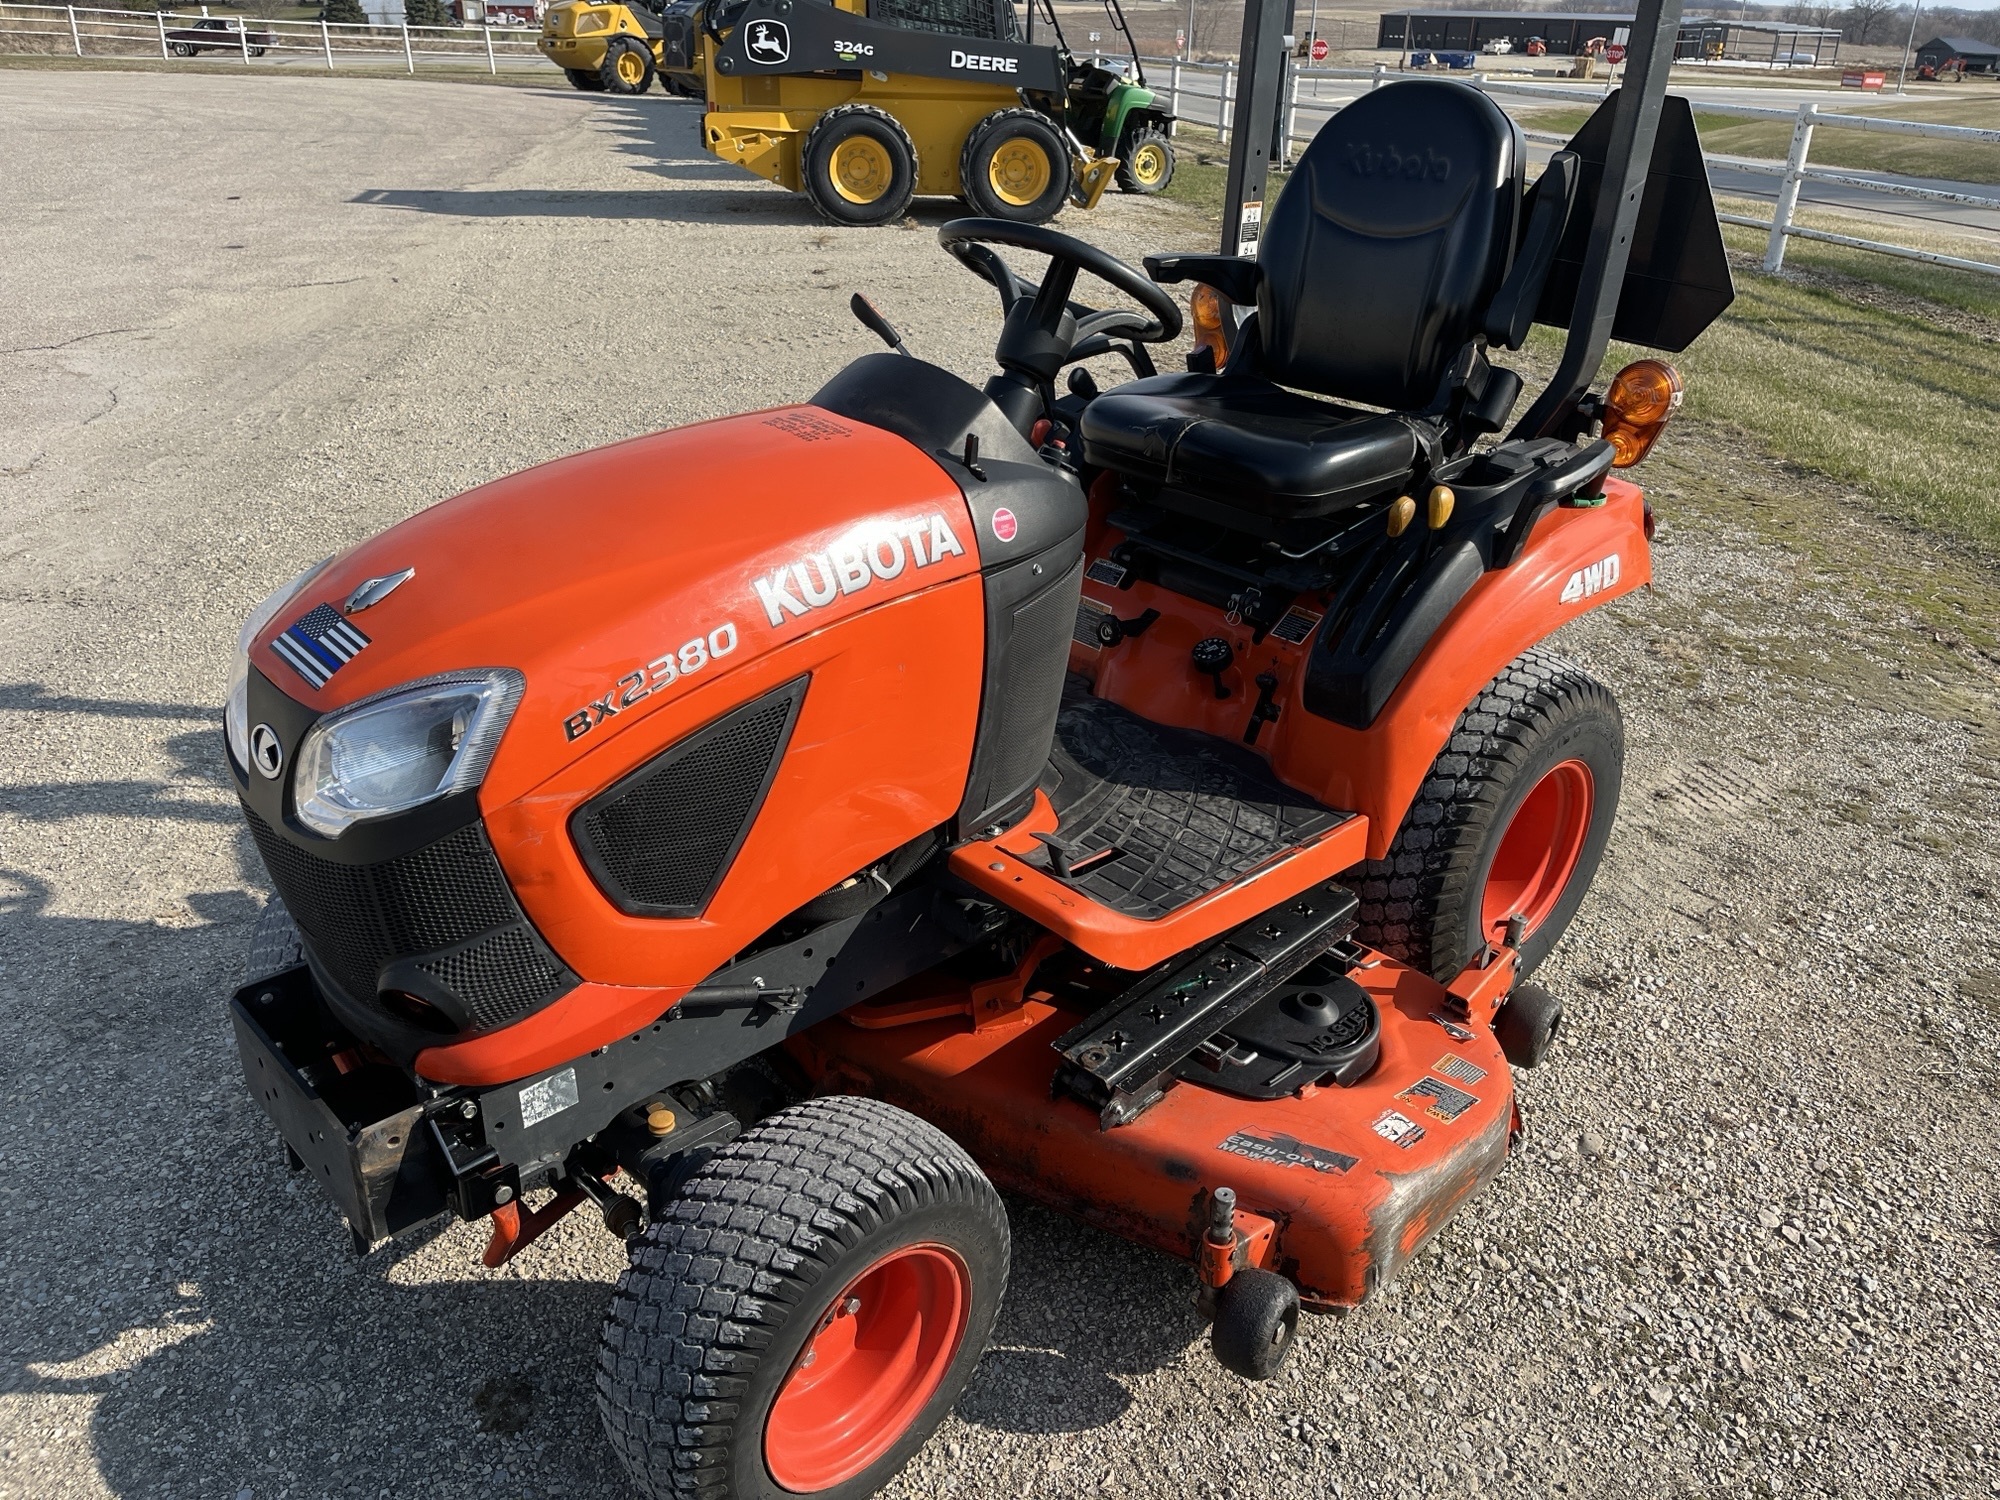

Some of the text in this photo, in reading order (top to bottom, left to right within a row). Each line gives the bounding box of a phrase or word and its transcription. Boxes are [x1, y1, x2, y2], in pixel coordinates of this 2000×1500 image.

[834, 40, 874, 56] 324G
[950, 50, 1018, 73] DEERE
[1312, 46, 1328, 55] STOP
[1607, 50, 1624, 59] STOP
[754, 513, 965, 628] KUBOTA
[1559, 553, 1620, 603] 4WD
[563, 621, 738, 743] BX2380
[1308, 1005, 1369, 1054] NO STEP
